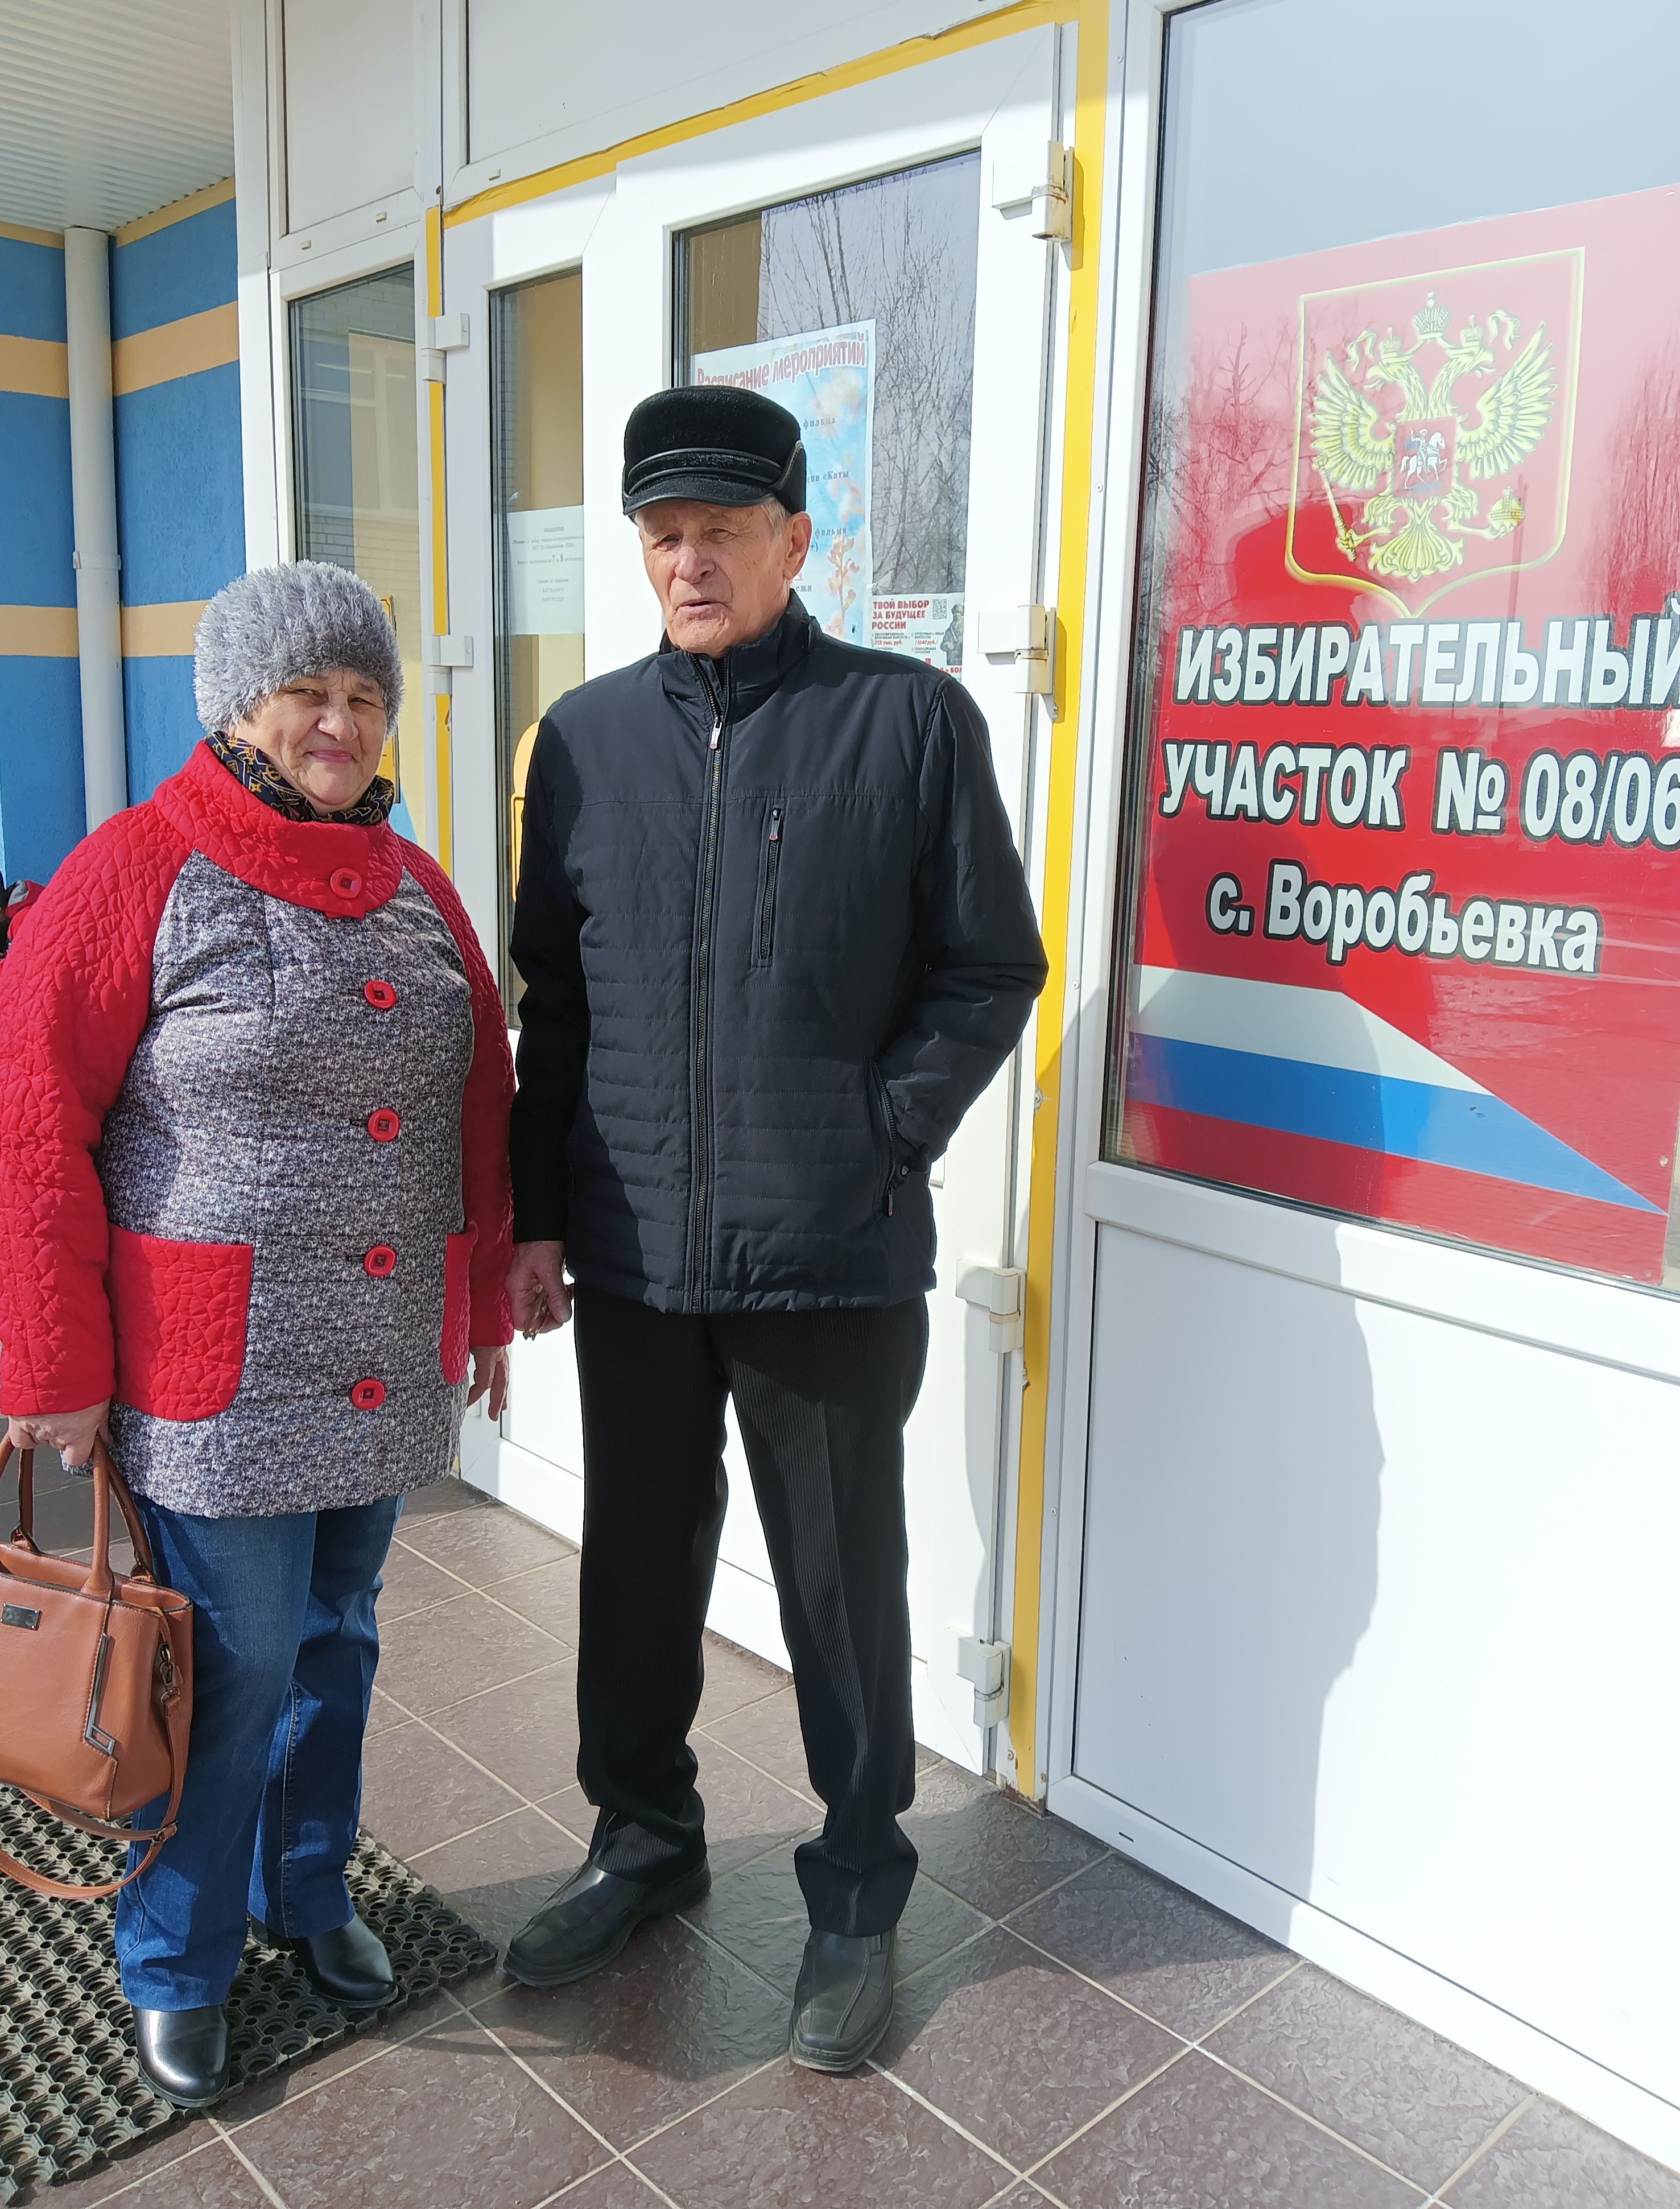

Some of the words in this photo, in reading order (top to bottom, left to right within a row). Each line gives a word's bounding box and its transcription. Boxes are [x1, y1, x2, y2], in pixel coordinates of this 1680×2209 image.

[772, 332, 865, 383] мероприятий
[872, 621, 906, 630] РОССИИ
[873, 598, 895, 609] ТВОЙ
[898, 600, 930, 609] ВЫБОР
[886, 610, 926, 620] БУДУЩЕЕ
[1175, 597, 1680, 704] ИЗБИРАТЕЛЬНЫЙ
[1163, 743, 1407, 826] УЧАСТОК
[1437, 752, 1506, 830] №
[1524, 753, 1680, 846] 08/06
[1210, 877, 1250, 931] с.
[1269, 863, 1598, 971] Воробьевка
